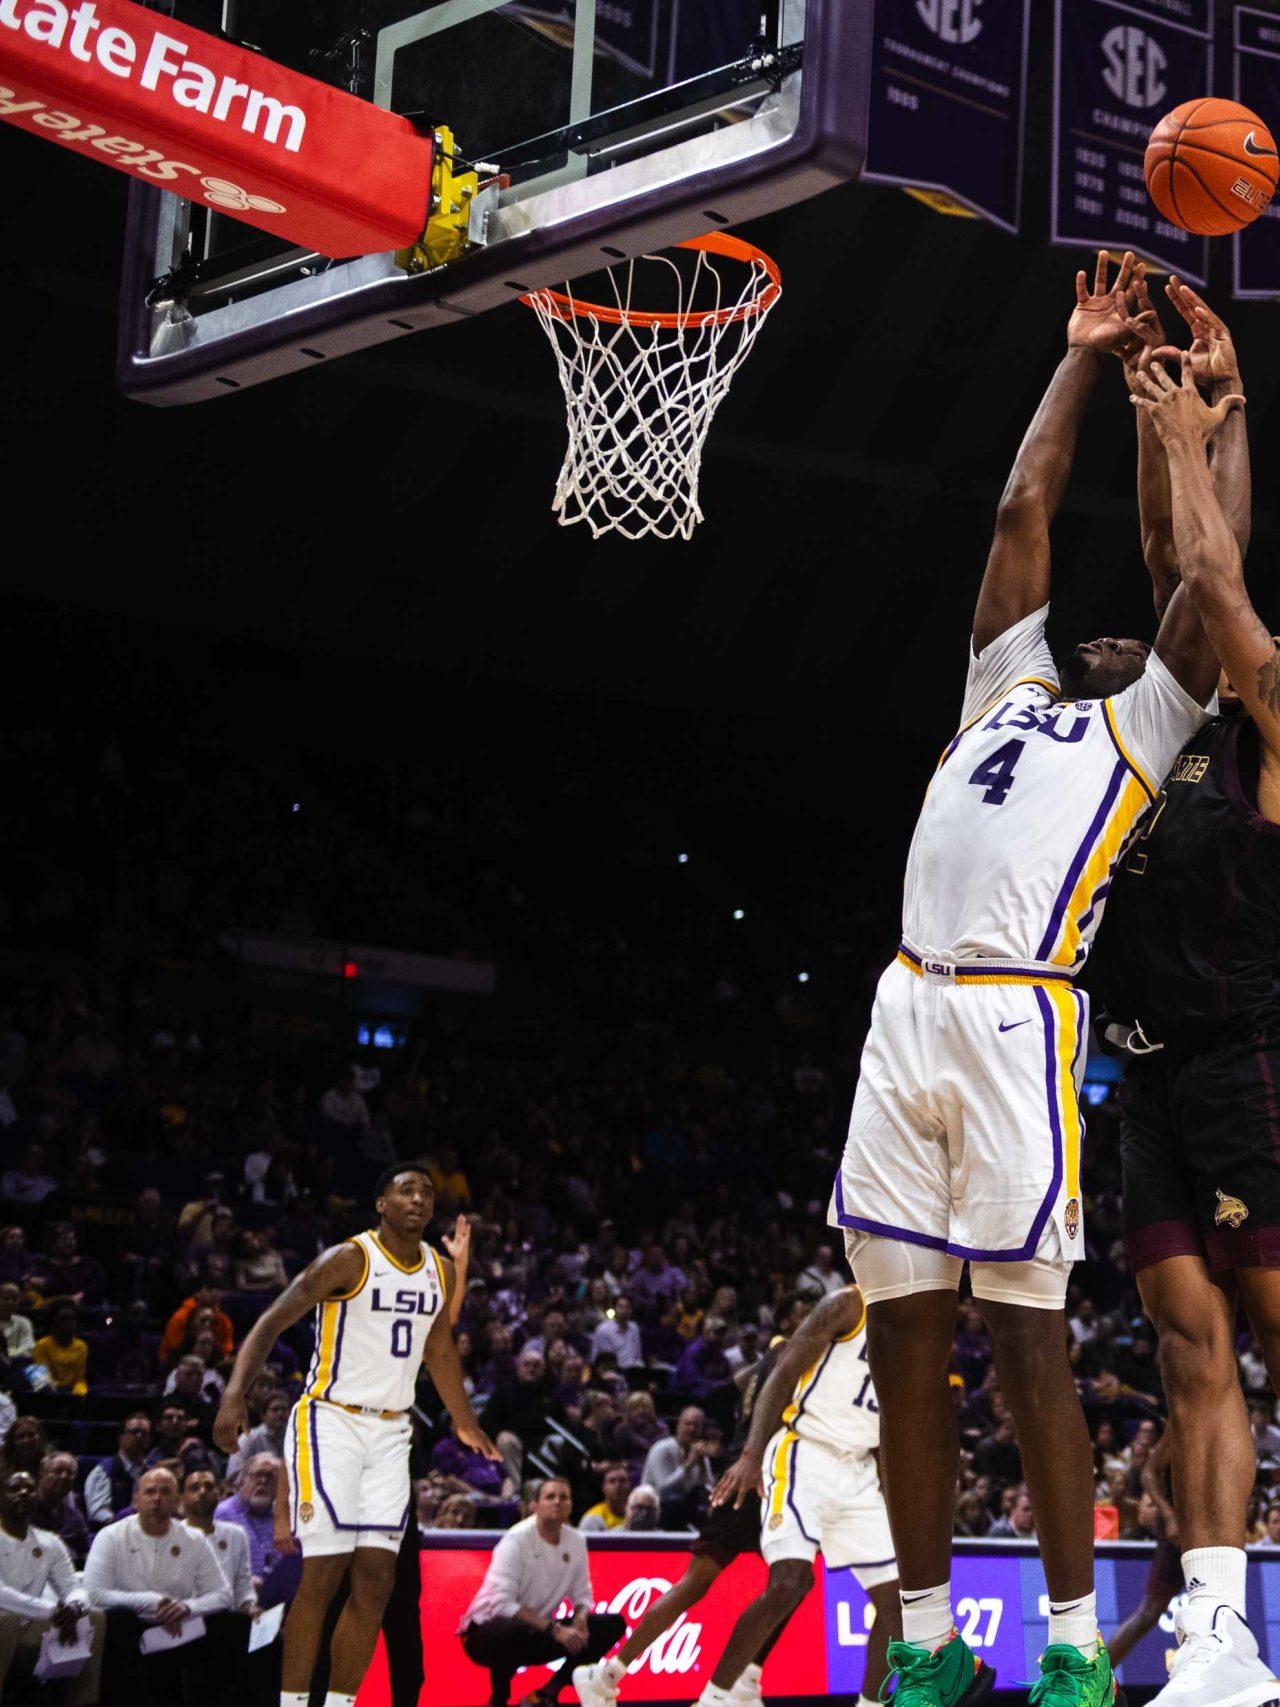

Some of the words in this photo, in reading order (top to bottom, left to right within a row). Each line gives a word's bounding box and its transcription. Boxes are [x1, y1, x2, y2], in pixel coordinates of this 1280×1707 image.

[0, 0, 137, 78] tate
[140, 31, 307, 153] Farm
[1101, 25, 1168, 108] SEC
[32, 110, 203, 181] State
[968, 738, 1027, 806] 4
[925, 961, 951, 976] LSU
[371, 1288, 438, 1316] LSU
[390, 1319, 412, 1358] 0
[956, 1597, 1003, 1647] 27
